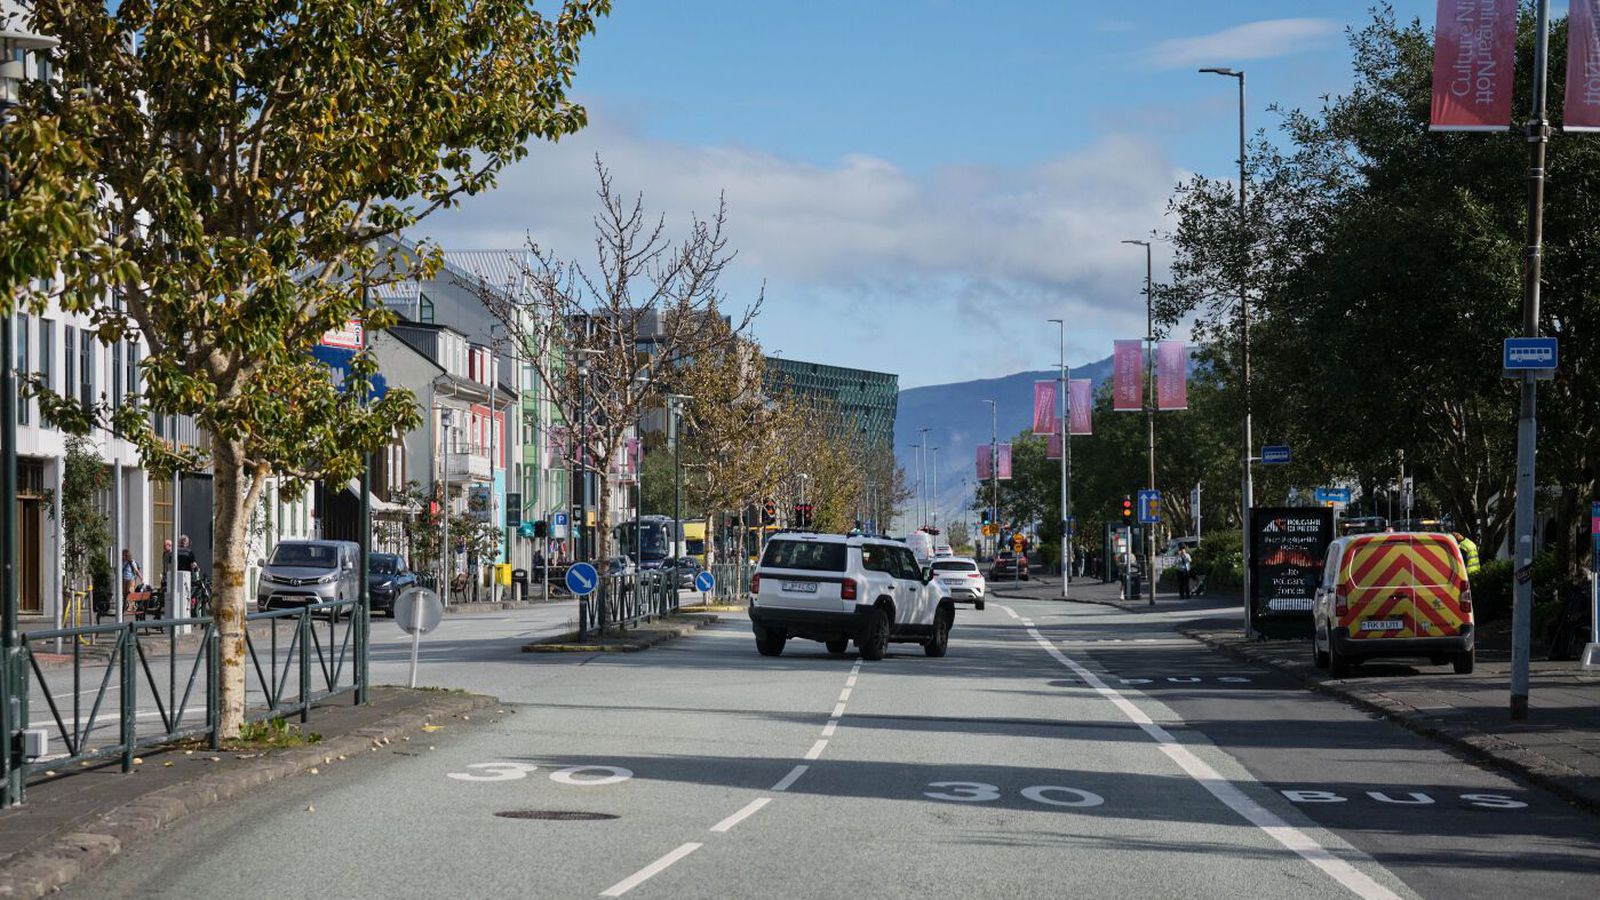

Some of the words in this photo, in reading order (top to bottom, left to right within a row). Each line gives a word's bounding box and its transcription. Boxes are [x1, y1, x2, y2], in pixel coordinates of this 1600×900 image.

[1451, 25, 1473, 97] Culture
[558, 515, 565, 524] P
[446, 762, 634, 785] 30
[923, 781, 1105, 807] 30
[1280, 789, 1529, 809] BUS
